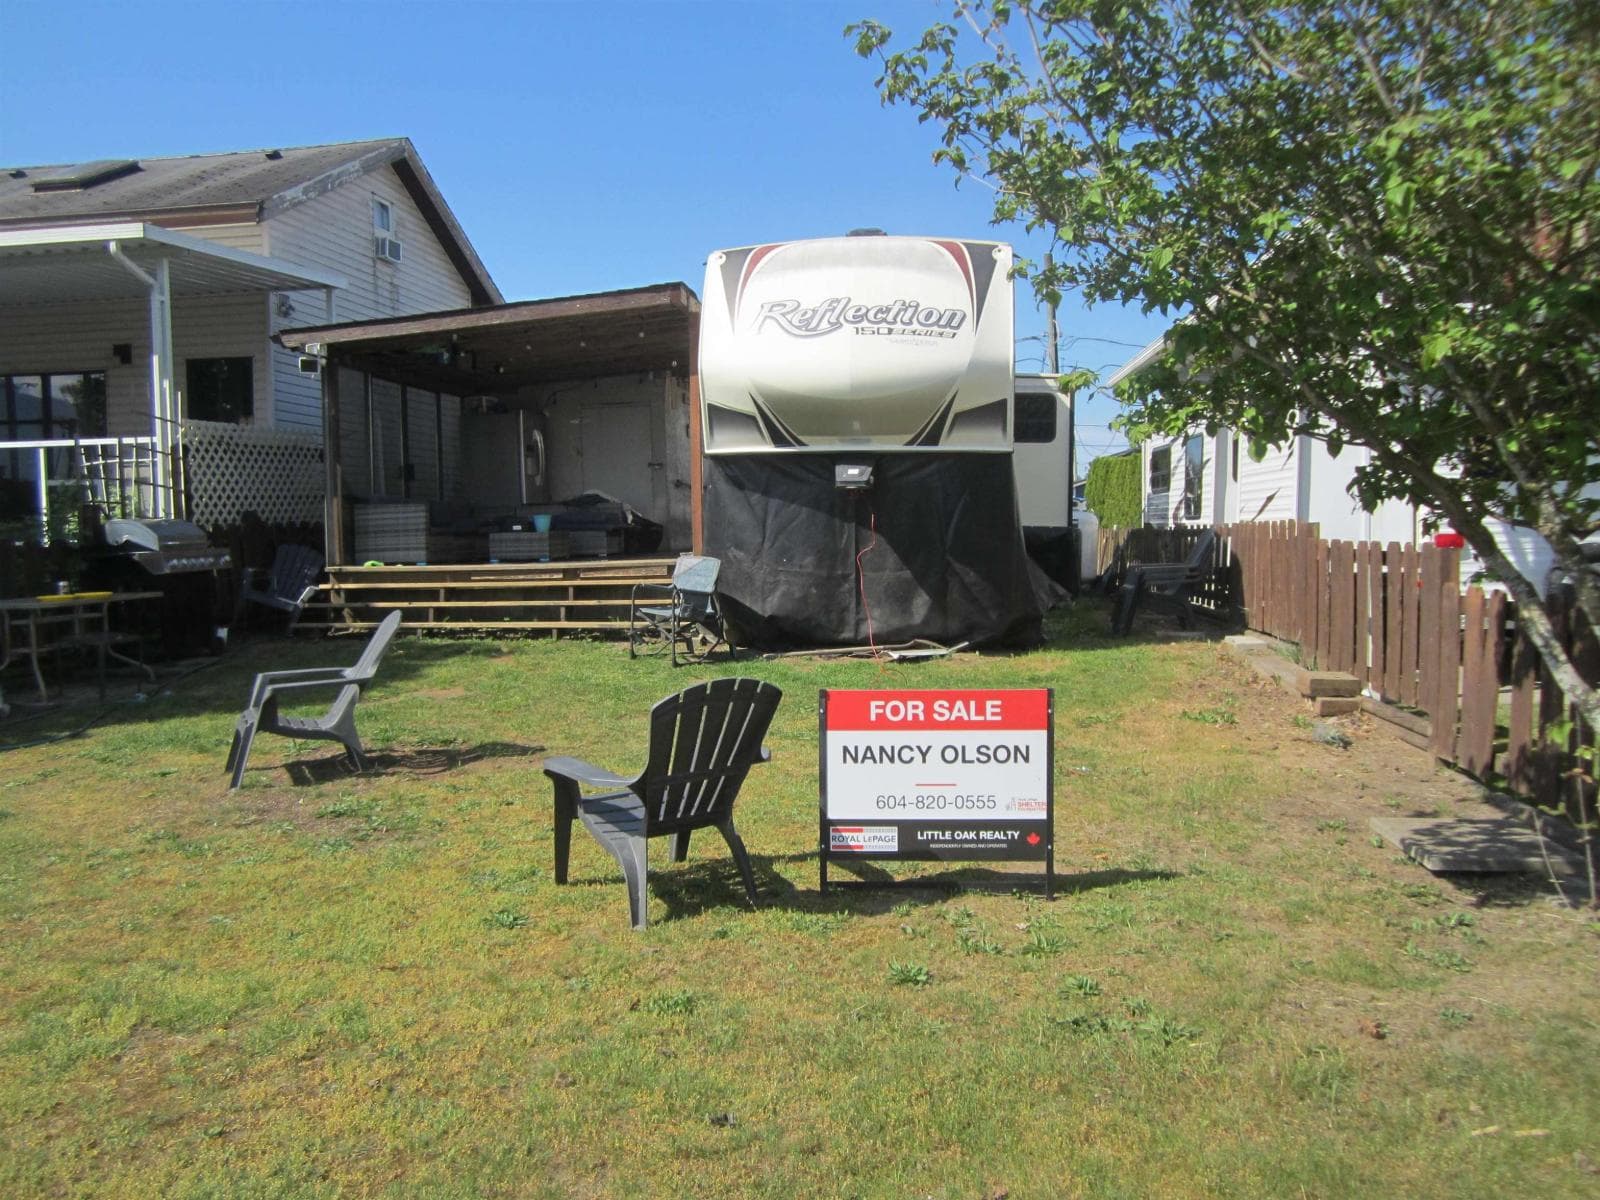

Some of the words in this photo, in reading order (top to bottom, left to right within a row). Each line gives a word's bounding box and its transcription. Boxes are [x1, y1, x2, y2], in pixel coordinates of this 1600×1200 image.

[750, 297, 967, 339] Reflection
[852, 327, 891, 335] 150
[891, 328, 957, 339] SERIES
[869, 700, 925, 721] FOR
[932, 700, 1002, 721] SALE
[842, 745, 932, 764] NANCY
[940, 745, 1031, 764] OLSON
[876, 795, 997, 810] 604-820-0555
[831, 835, 861, 843] ROYAL
[917, 830, 952, 840] LITTLE
[954, 830, 977, 840] OAK
[979, 830, 1020, 840] REALTY
